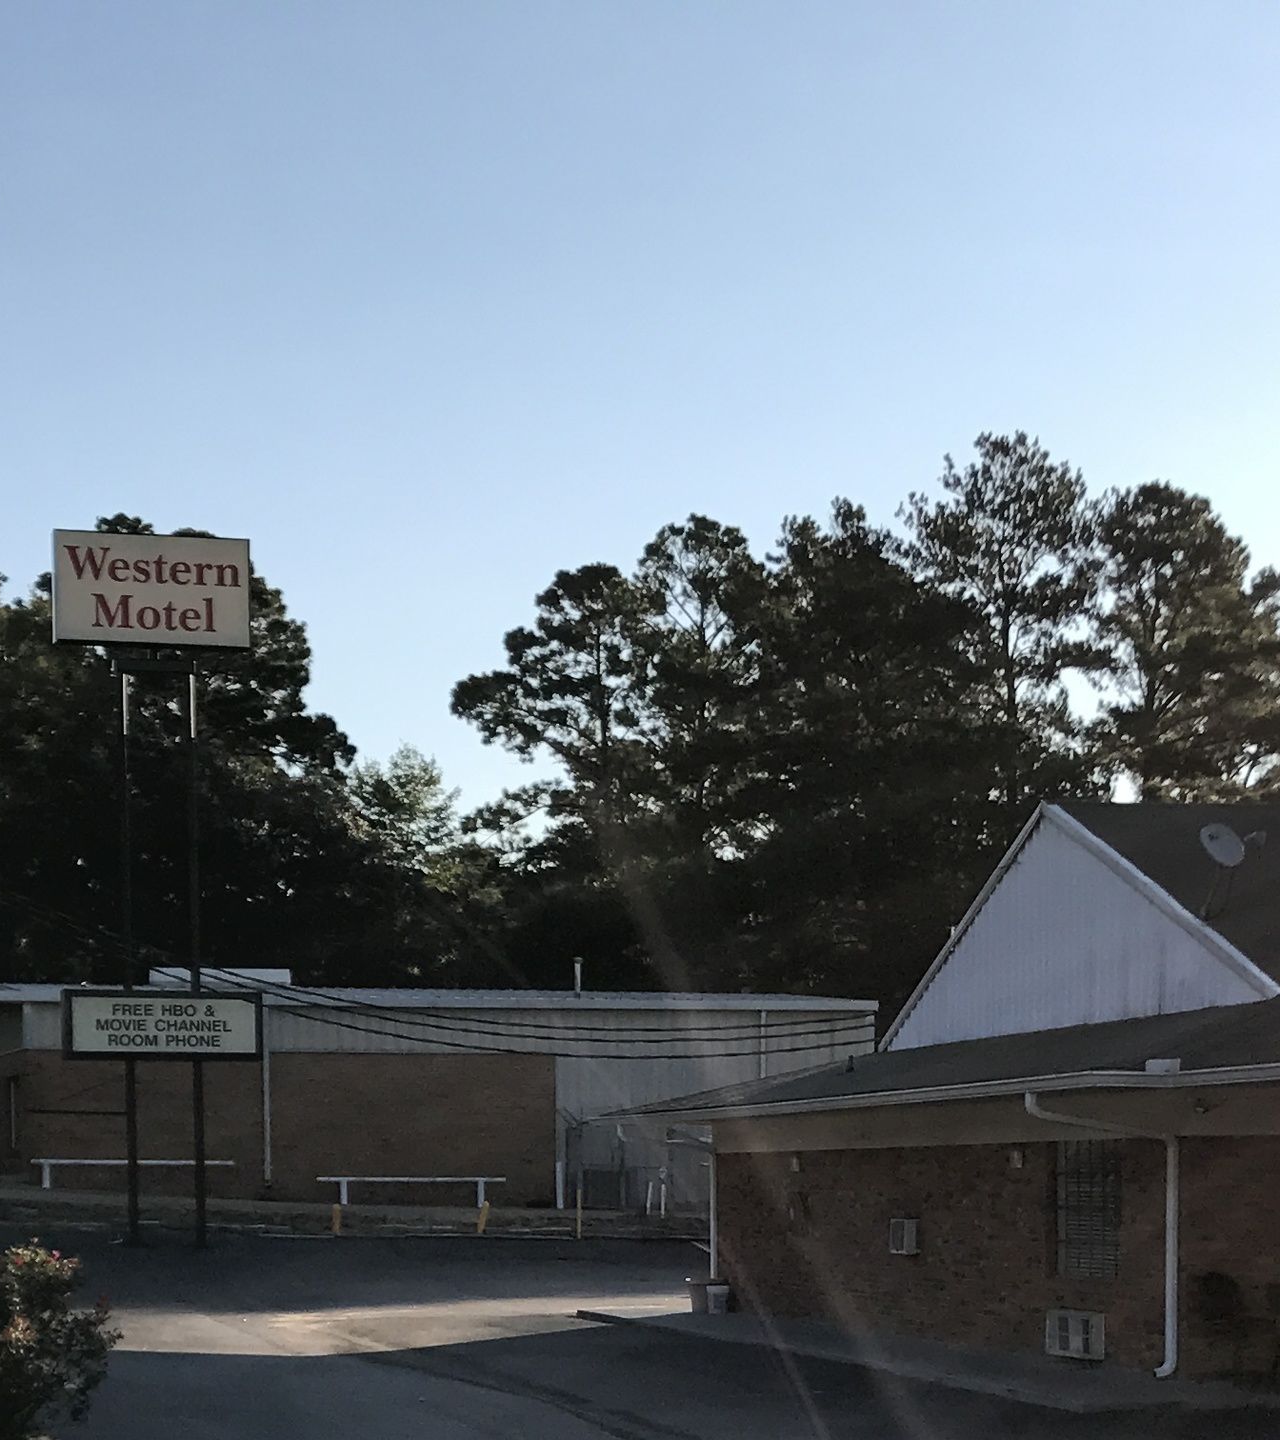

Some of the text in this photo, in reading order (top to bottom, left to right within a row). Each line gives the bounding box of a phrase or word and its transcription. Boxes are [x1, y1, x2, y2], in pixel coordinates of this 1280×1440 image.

[63, 545, 241, 588] Western
[91, 593, 217, 633] Motel
[111, 1003, 215, 1017] FREE HBO &
[95, 1018, 233, 1033] MOVIE CHANNEL
[107, 1033, 221, 1047] ROOM PHONE
